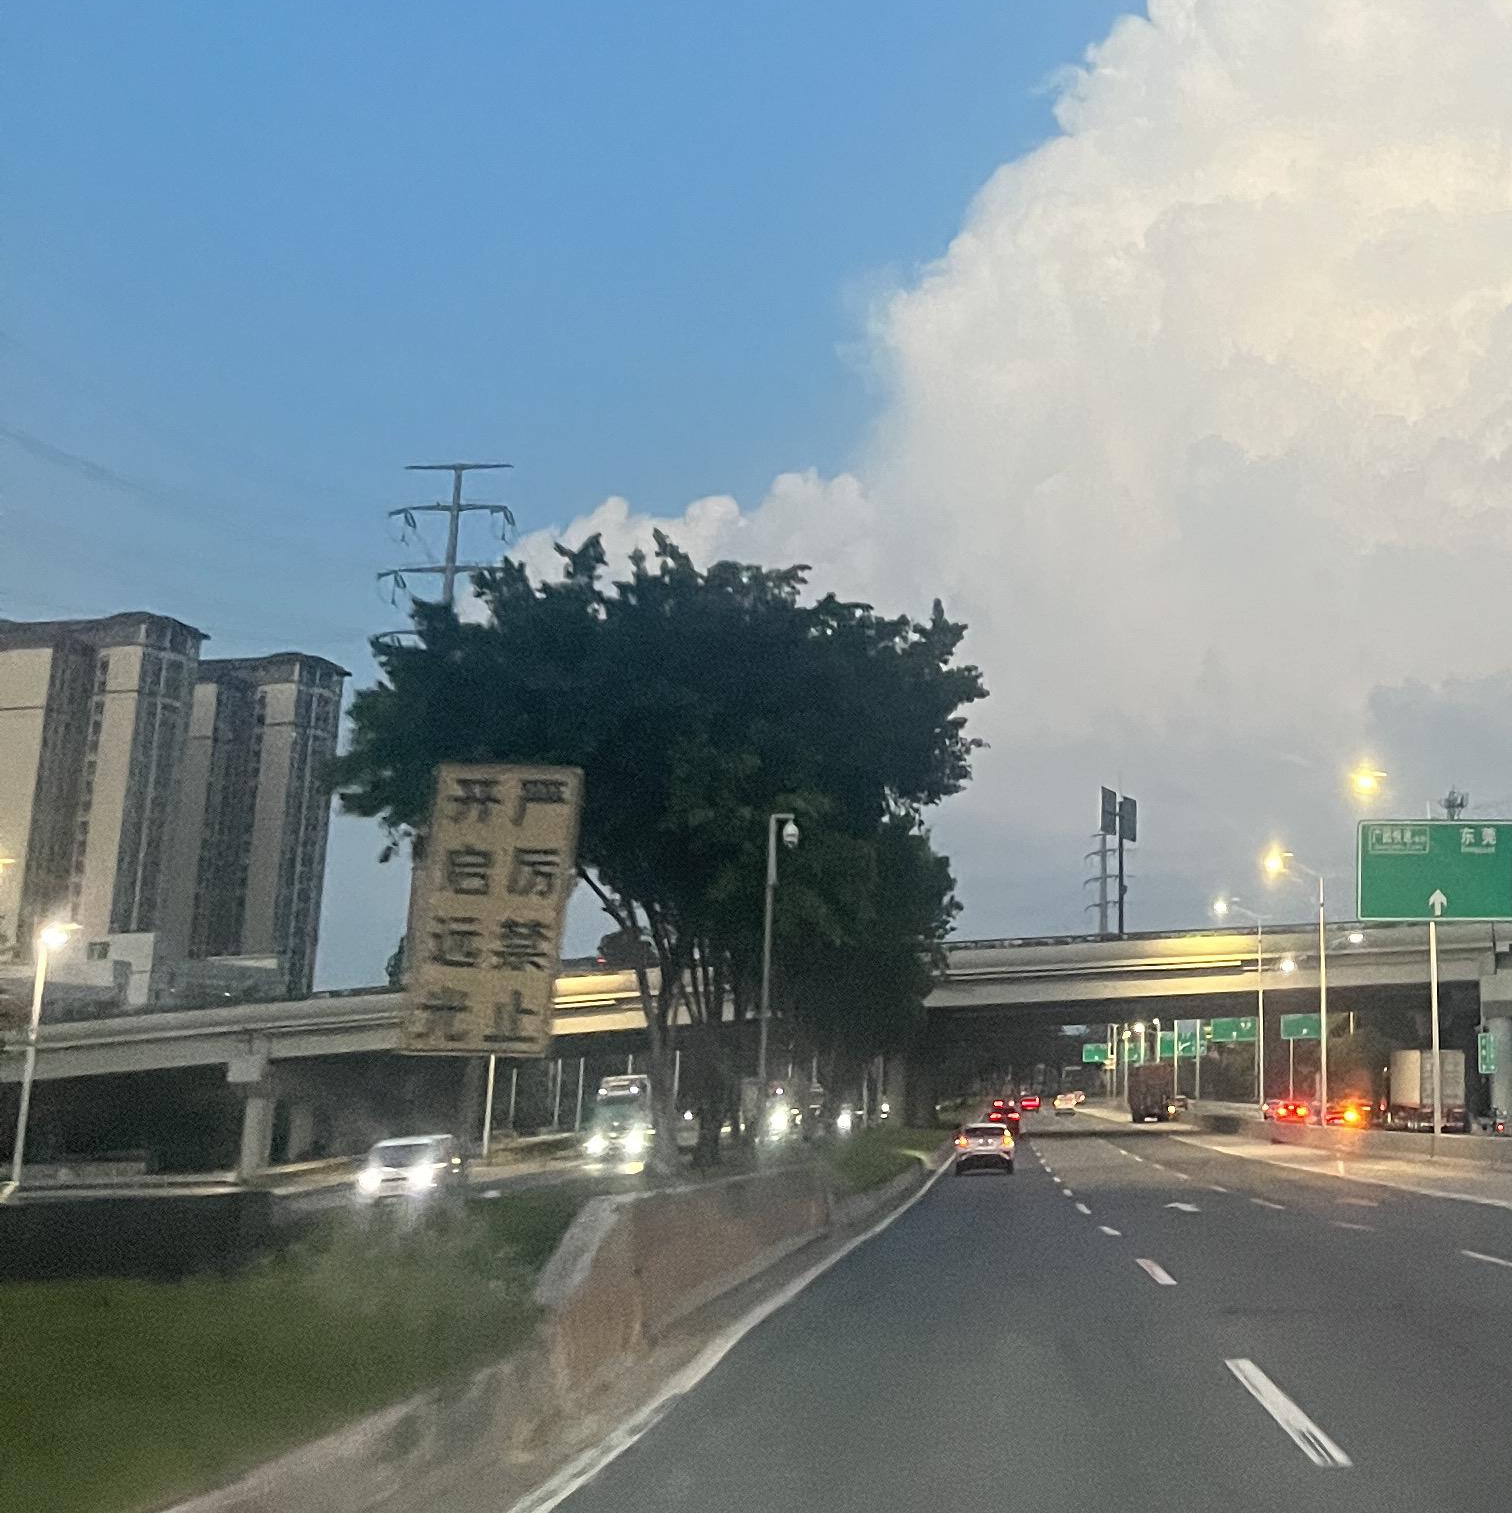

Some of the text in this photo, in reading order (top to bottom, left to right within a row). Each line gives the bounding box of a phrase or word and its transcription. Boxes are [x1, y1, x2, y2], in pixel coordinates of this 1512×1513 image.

[414, 776, 502, 1043] 开启远光
[483, 776, 569, 1043] 严厉禁止
[1459, 827, 1497, 845] 东莞
